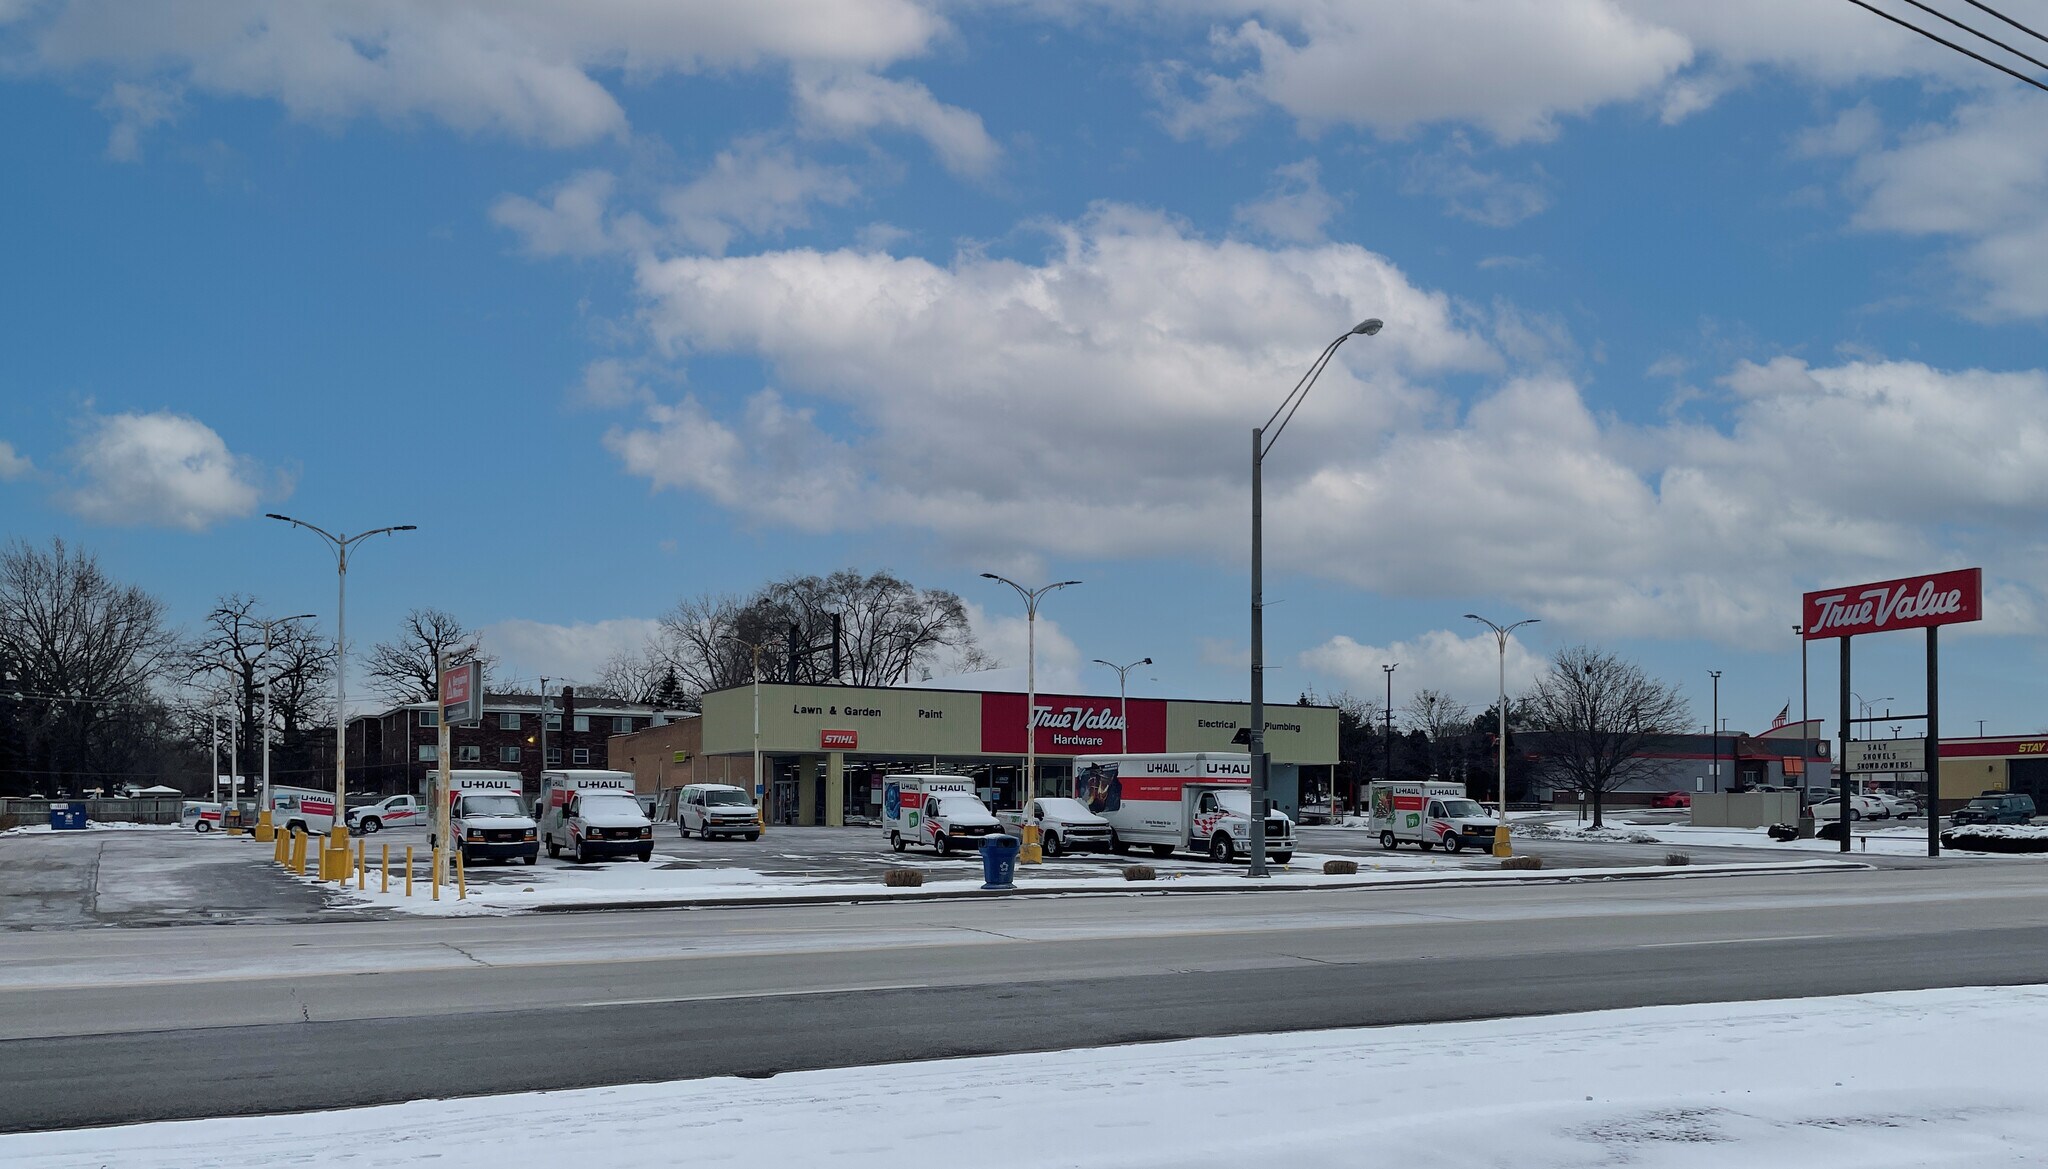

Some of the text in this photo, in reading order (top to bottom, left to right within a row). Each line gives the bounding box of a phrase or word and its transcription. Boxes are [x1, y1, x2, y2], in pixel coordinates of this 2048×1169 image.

[1809, 580, 1962, 634] True Value
[793, 704, 881, 717] Lawn & Garden
[918, 709, 943, 719] Paint
[1198, 719, 1237, 729] Electrical
[1264, 722, 1301, 733] Plumbing
[824, 735, 855, 744] STIHL
[1053, 734, 1103, 746] Hardware
[1867, 743, 1887, 751] SALT
[2018, 742, 2046, 752] STAY
[1147, 763, 1180, 773] U-HAUL
[461, 780, 511, 789] U-HAUL
[577, 780, 625, 789] U-HAUL
[901, 783, 919, 791] U-HAUL
[929, 784, 967, 792] U-HAUL
[301, 794, 332, 804] U-HAUL
